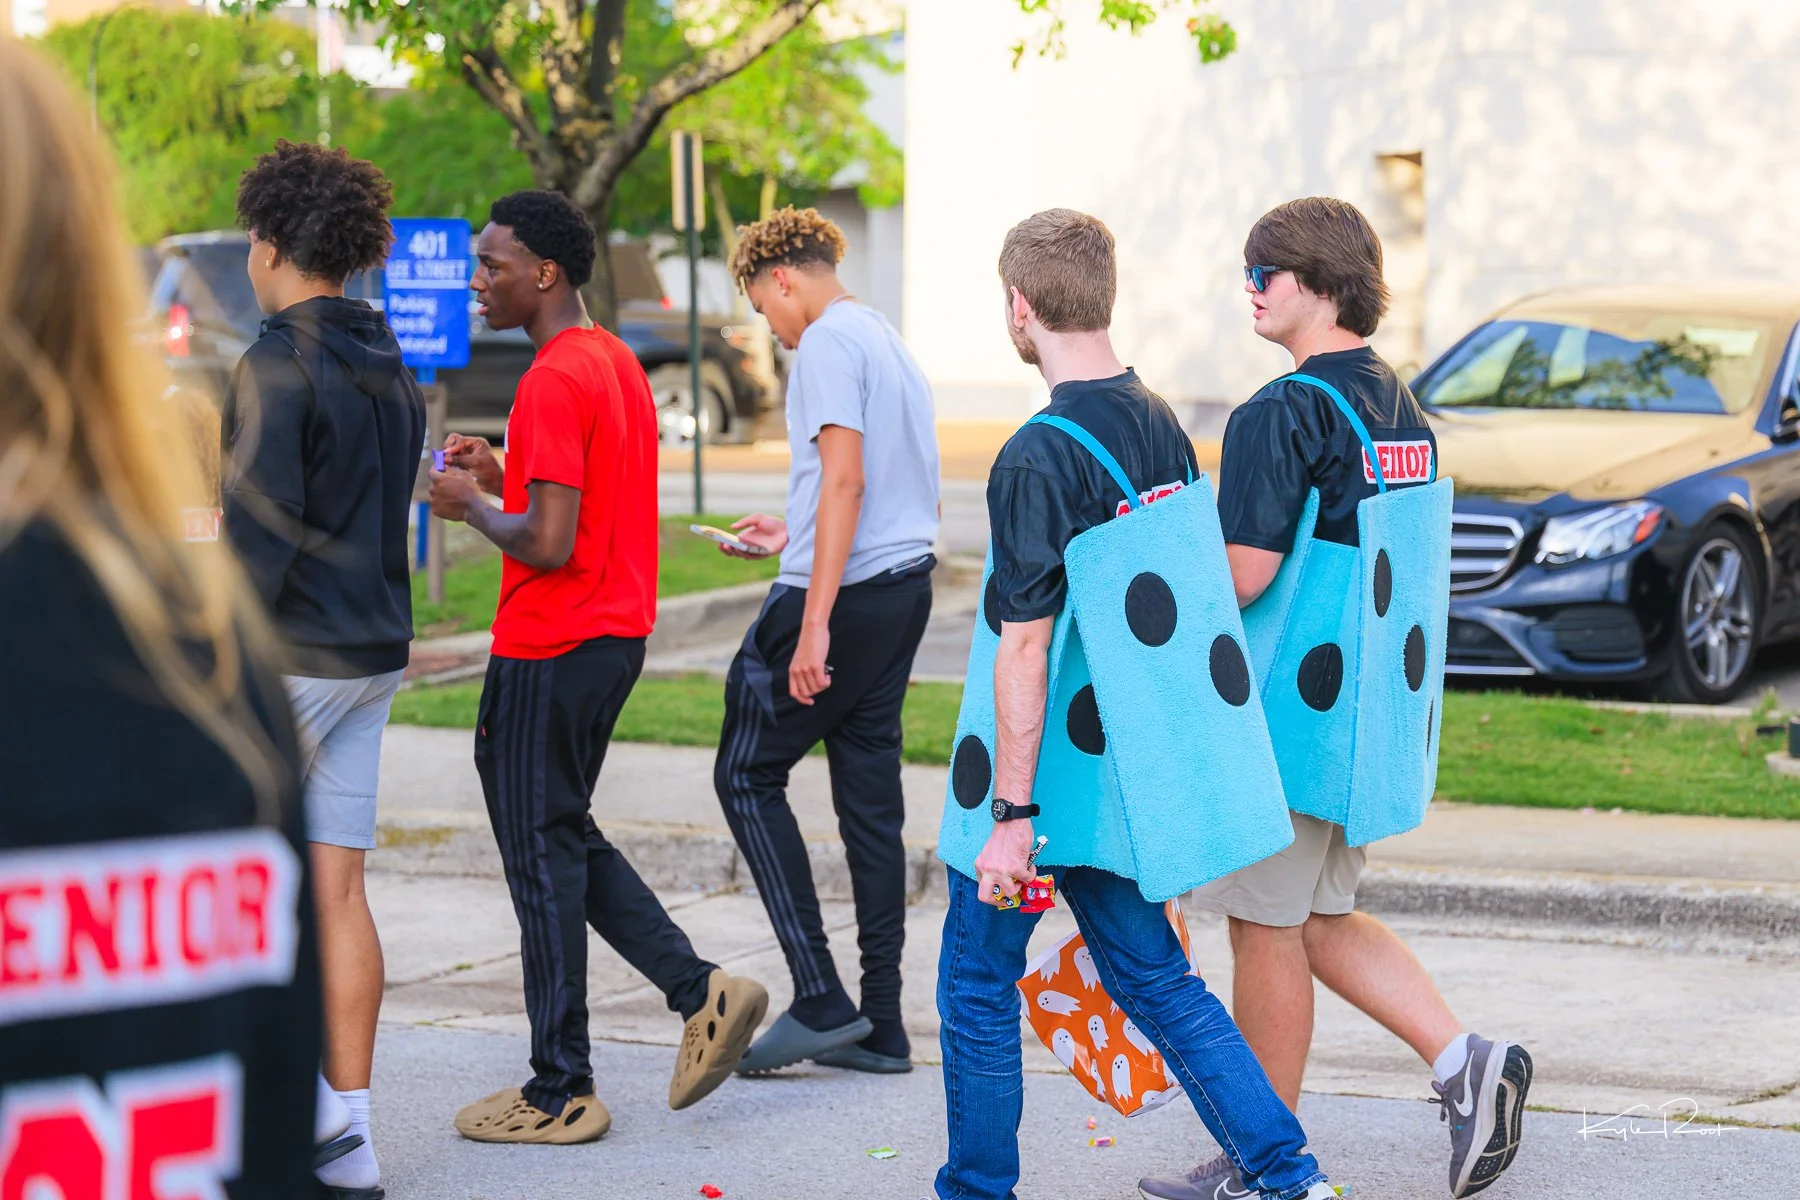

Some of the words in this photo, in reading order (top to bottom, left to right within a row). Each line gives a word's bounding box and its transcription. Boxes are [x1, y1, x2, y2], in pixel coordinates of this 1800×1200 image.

[408, 230, 447, 259] 401
[414, 260, 467, 279] STREET
[389, 294, 437, 317] Parking
[397, 334, 448, 355] nforced
